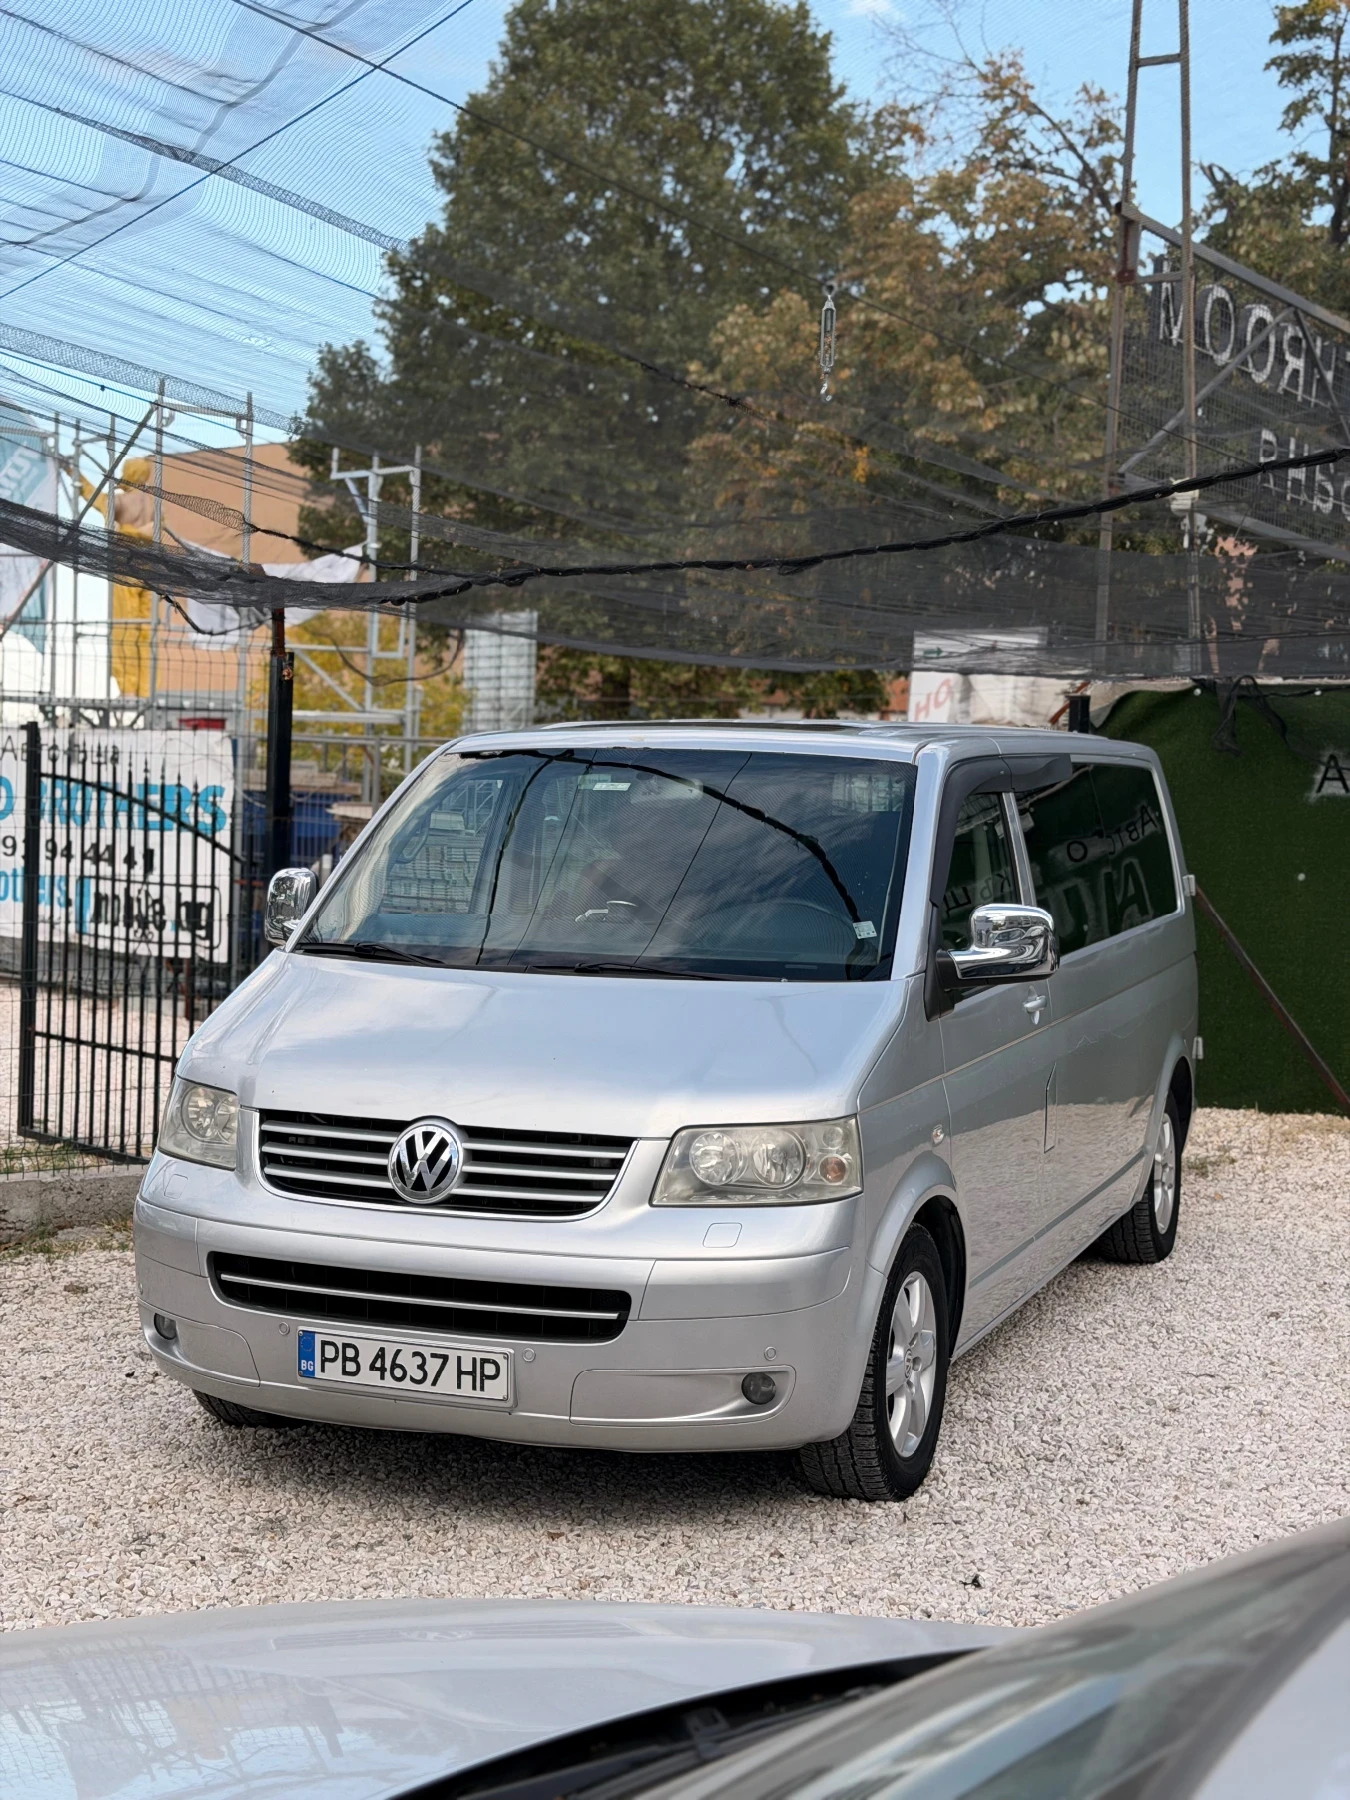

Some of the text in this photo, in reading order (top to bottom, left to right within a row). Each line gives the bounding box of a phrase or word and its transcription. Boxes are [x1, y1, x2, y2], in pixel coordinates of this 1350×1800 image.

[301, 1360, 314, 1371] BG
[320, 1339, 501, 1392] PB 4637 HP
